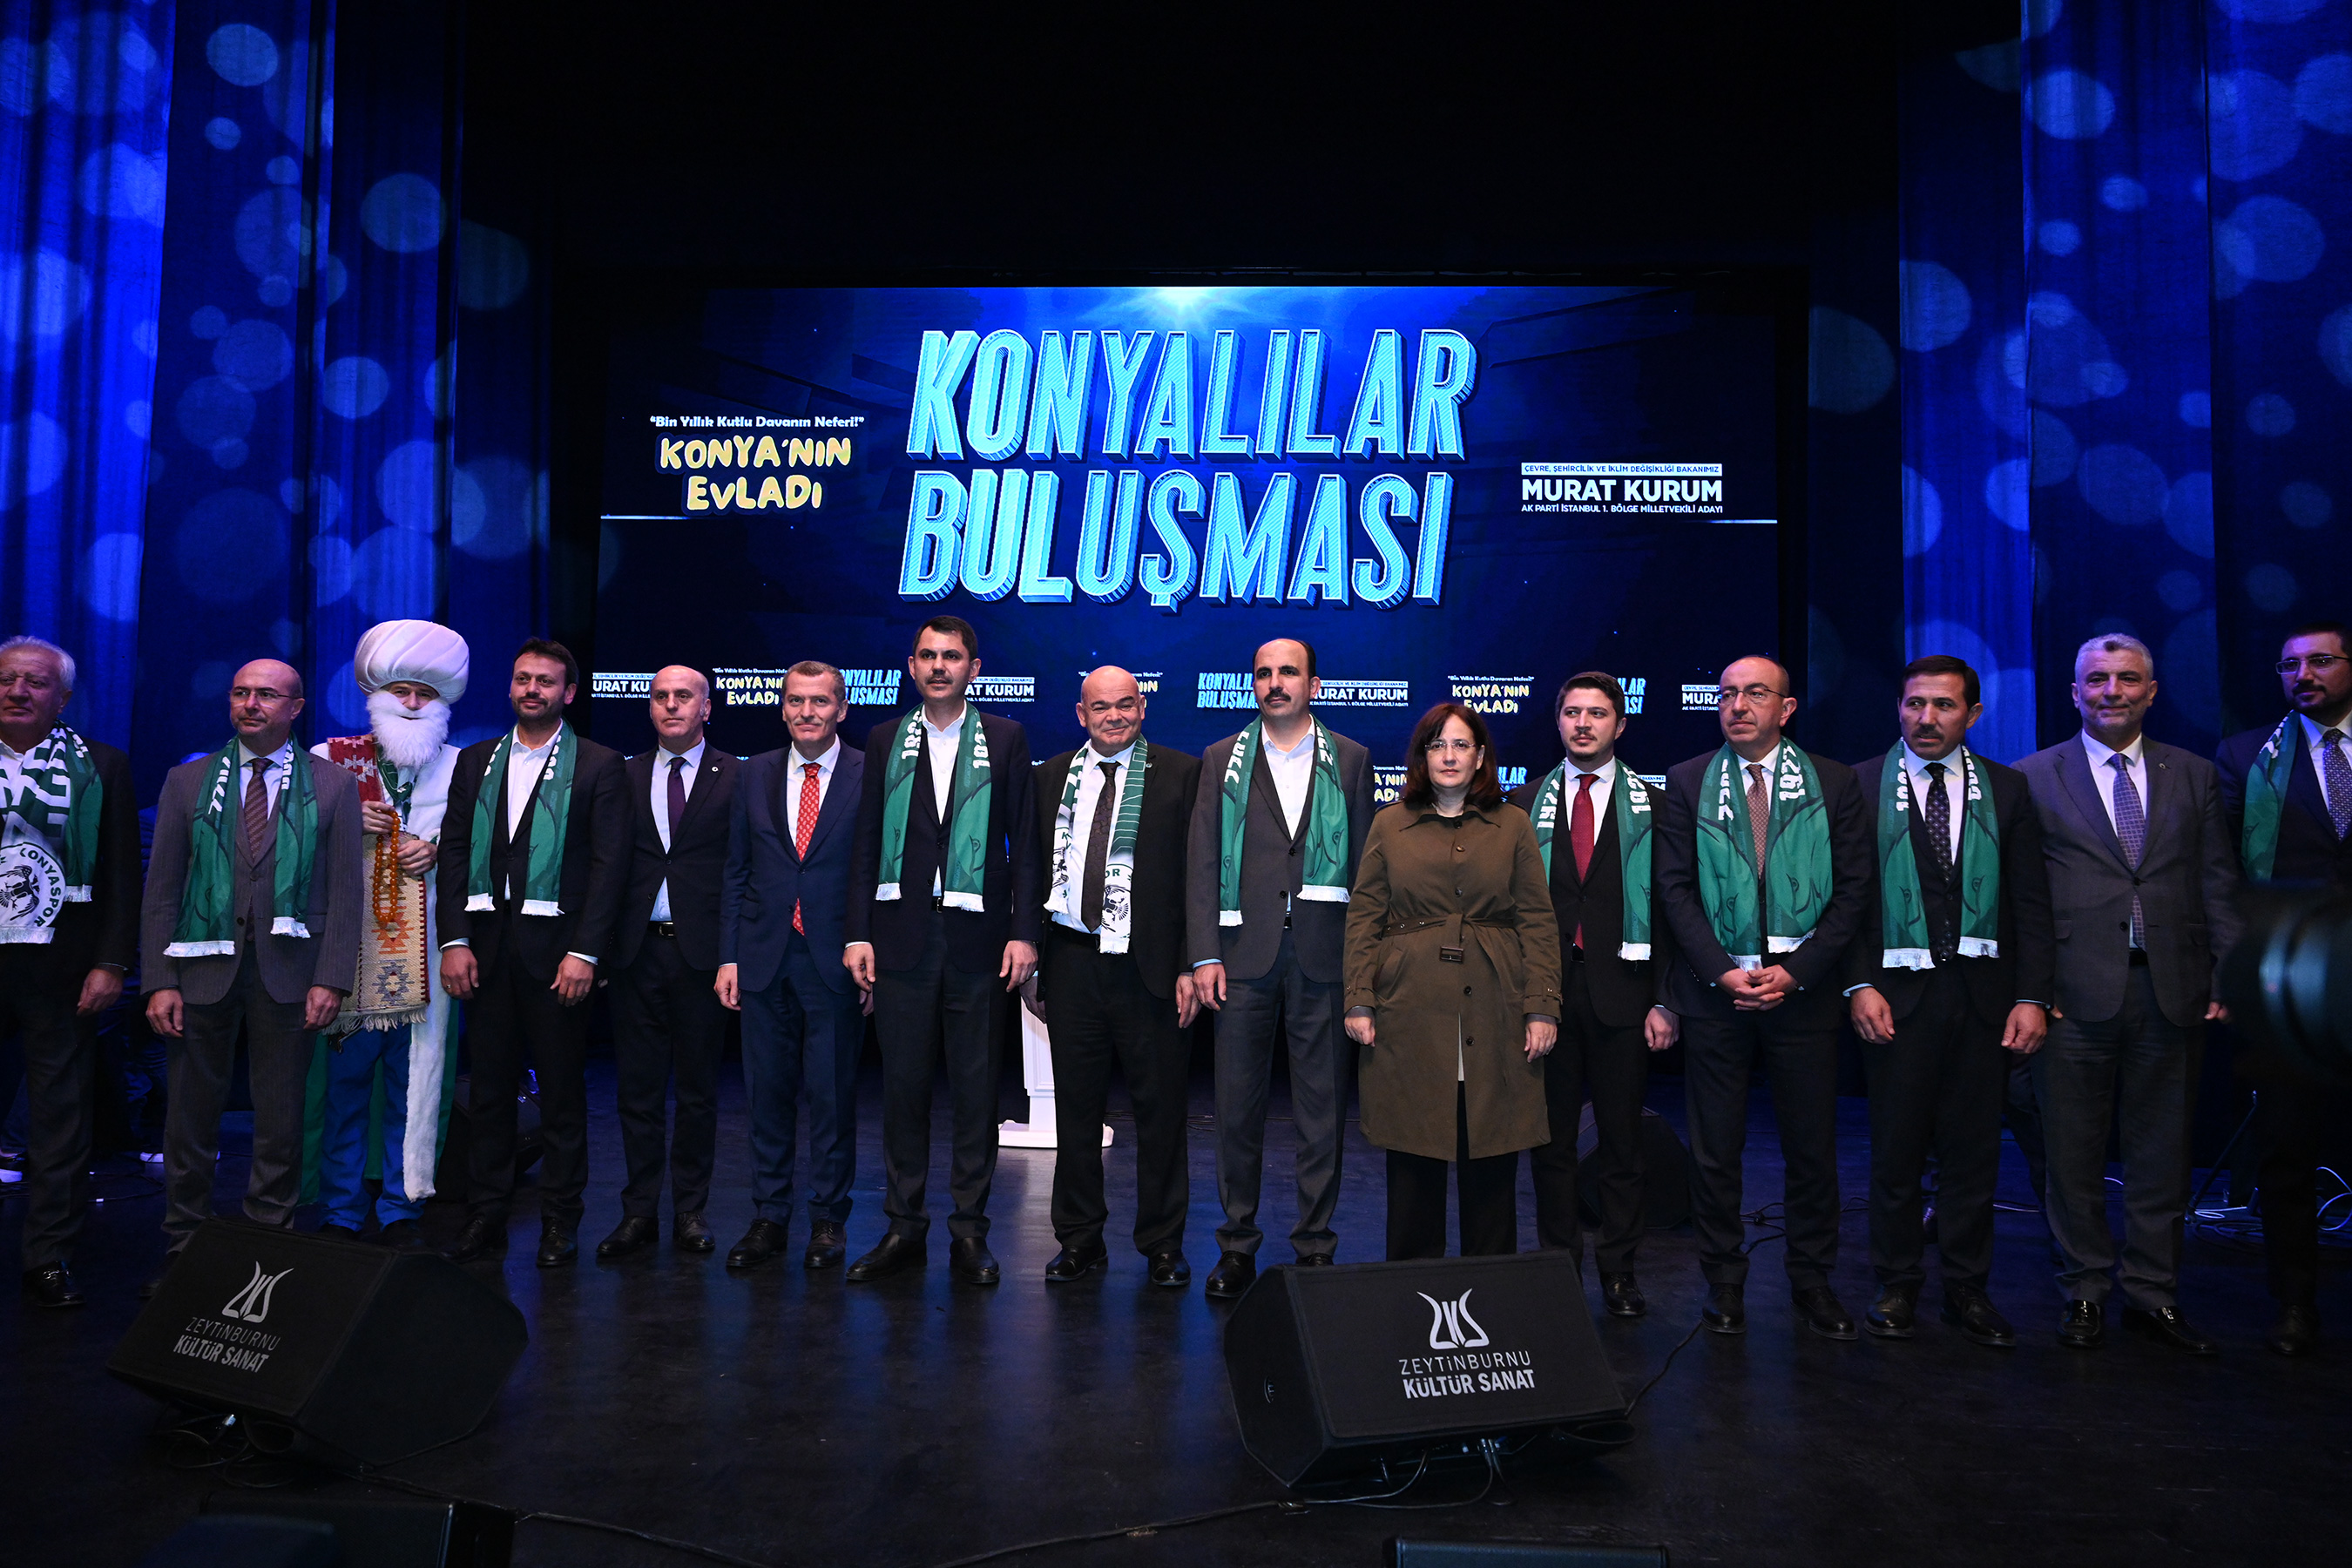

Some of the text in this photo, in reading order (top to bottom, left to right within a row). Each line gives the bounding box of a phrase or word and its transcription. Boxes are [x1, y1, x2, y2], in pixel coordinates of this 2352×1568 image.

[906, 328, 1478, 462] KONYALILAR
[717, 416, 753, 427] Kutlu
[1522, 479, 1722, 503] MURAT KURUM
[1535, 504, 1559, 512] PARTİ
[1561, 504, 1601, 512] İSTANBUL
[1611, 504, 1639, 512] BÖLGE
[1640, 504, 1696, 513] MİLLETVEKİLİ
[897, 470, 1456, 613] BULUŞMASI
[592, 680, 629, 692] URAT
[985, 684, 1035, 696] KURUM
[1198, 672, 1254, 691] KONYALIL
[1197, 690, 1260, 710] BULUŞMA
[1314, 687, 1409, 700] URAT KURUM
[221, 1346, 270, 1373] SANAT
[1477, 1369, 1535, 1392] SANAT
